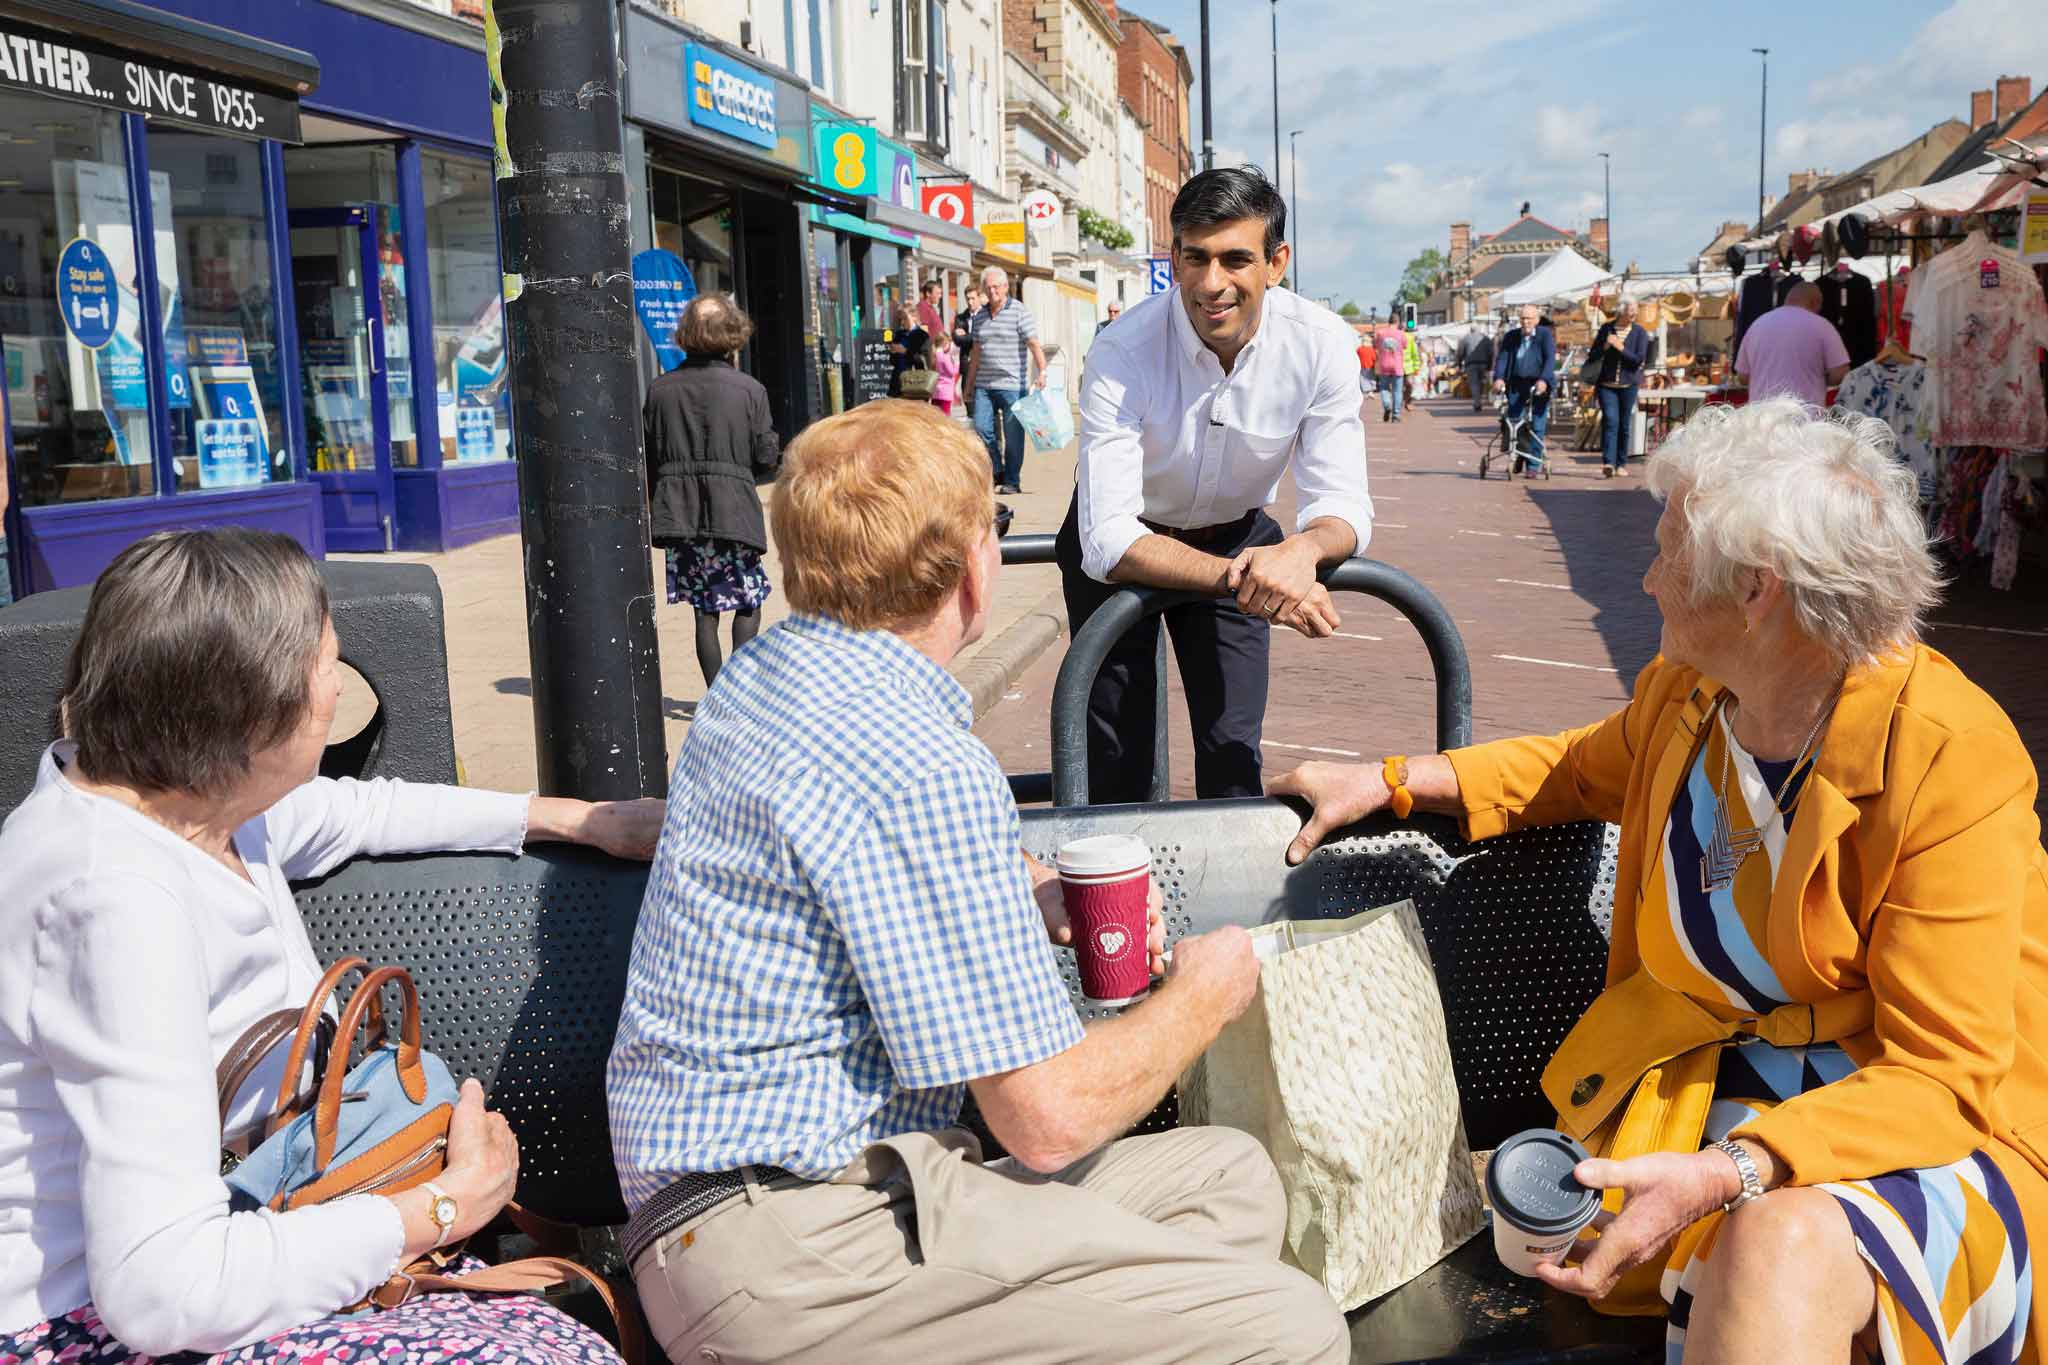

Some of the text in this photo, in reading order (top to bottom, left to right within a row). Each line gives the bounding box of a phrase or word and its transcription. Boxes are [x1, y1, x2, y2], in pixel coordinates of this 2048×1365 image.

[124, 62, 198, 118] SINCE
[208, 82, 265, 131] 1955-
[713, 68, 776, 134] GREGGS
[69, 266, 105, 285] Stay safe
